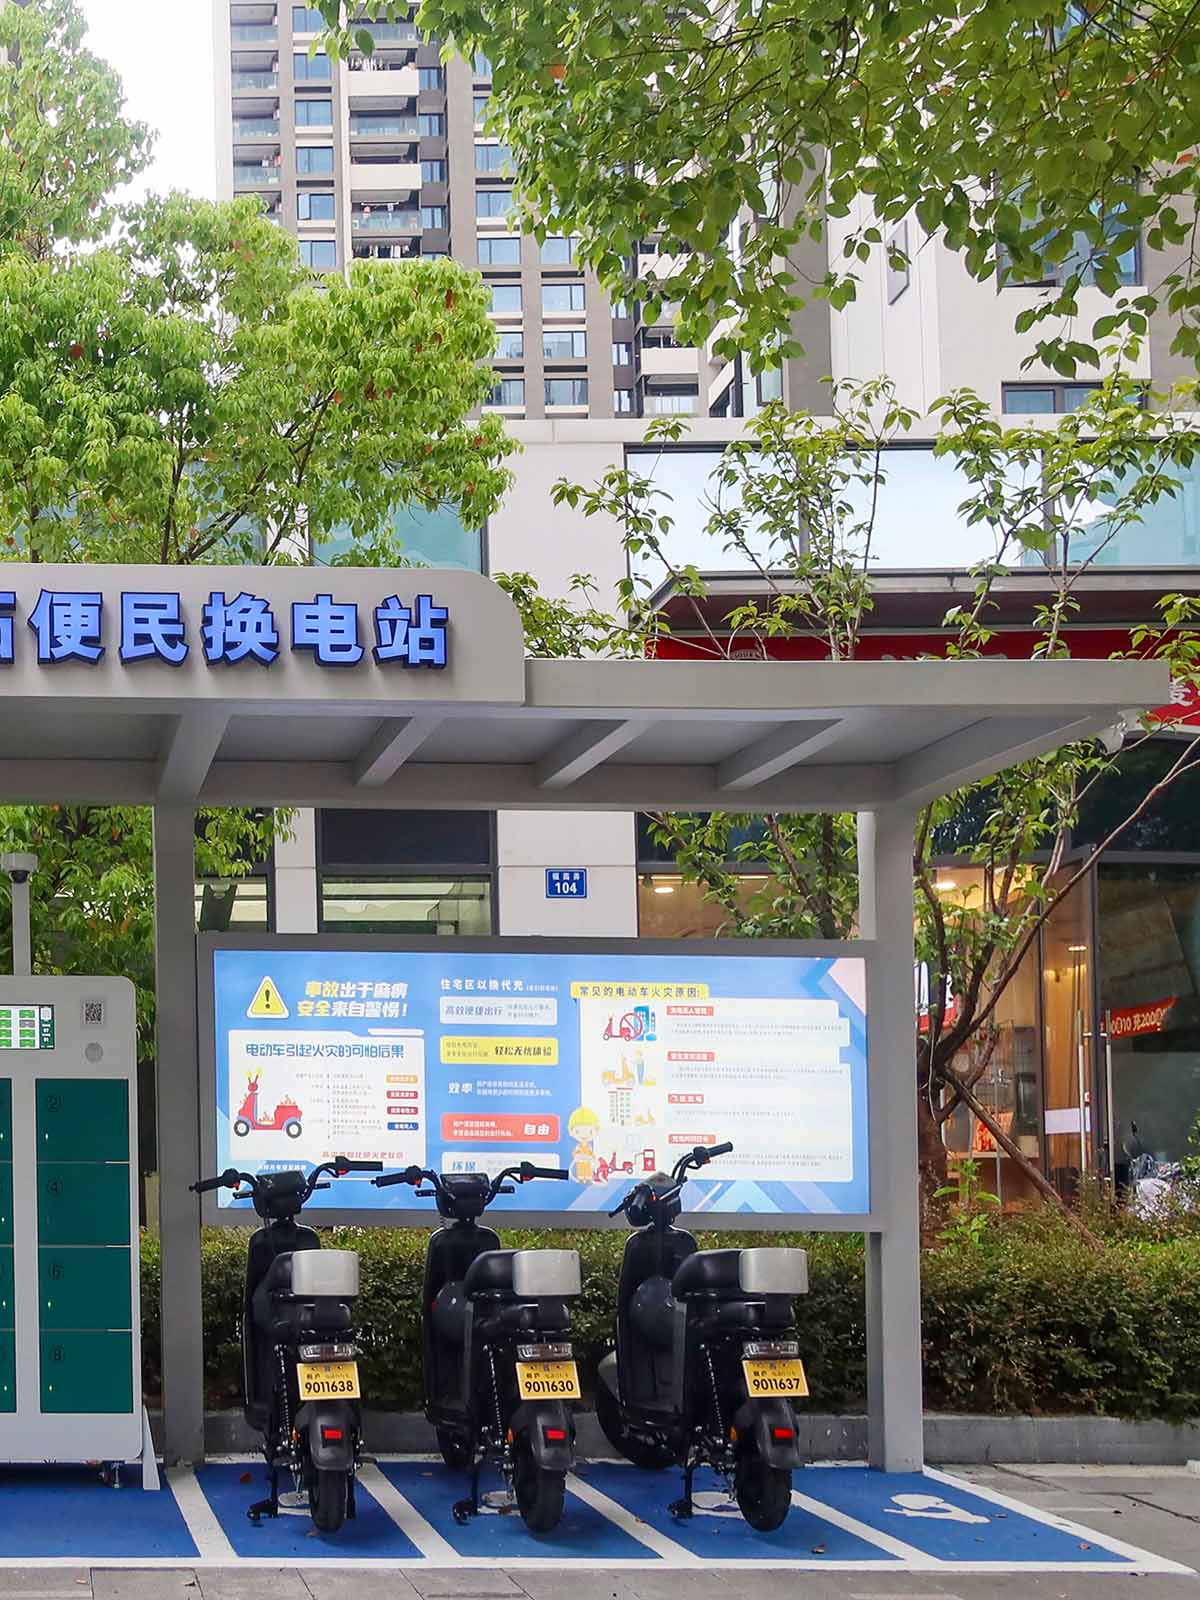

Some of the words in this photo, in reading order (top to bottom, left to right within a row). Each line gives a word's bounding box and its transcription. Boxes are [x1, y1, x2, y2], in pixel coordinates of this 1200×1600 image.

[554, 881, 577, 894] 104
[305, 981, 408, 998] 事故出于麻痹
[297, 1001, 408, 1018] 安全来自警惕！
[246, 1043, 405, 1059] 电动车引起火灾的可怕后果
[523, 1123, 551, 1136] 自由
[305, 1380, 354, 1393] 9011638
[524, 1380, 574, 1393] 9011630
[752, 1378, 800, 1391] 9011637
